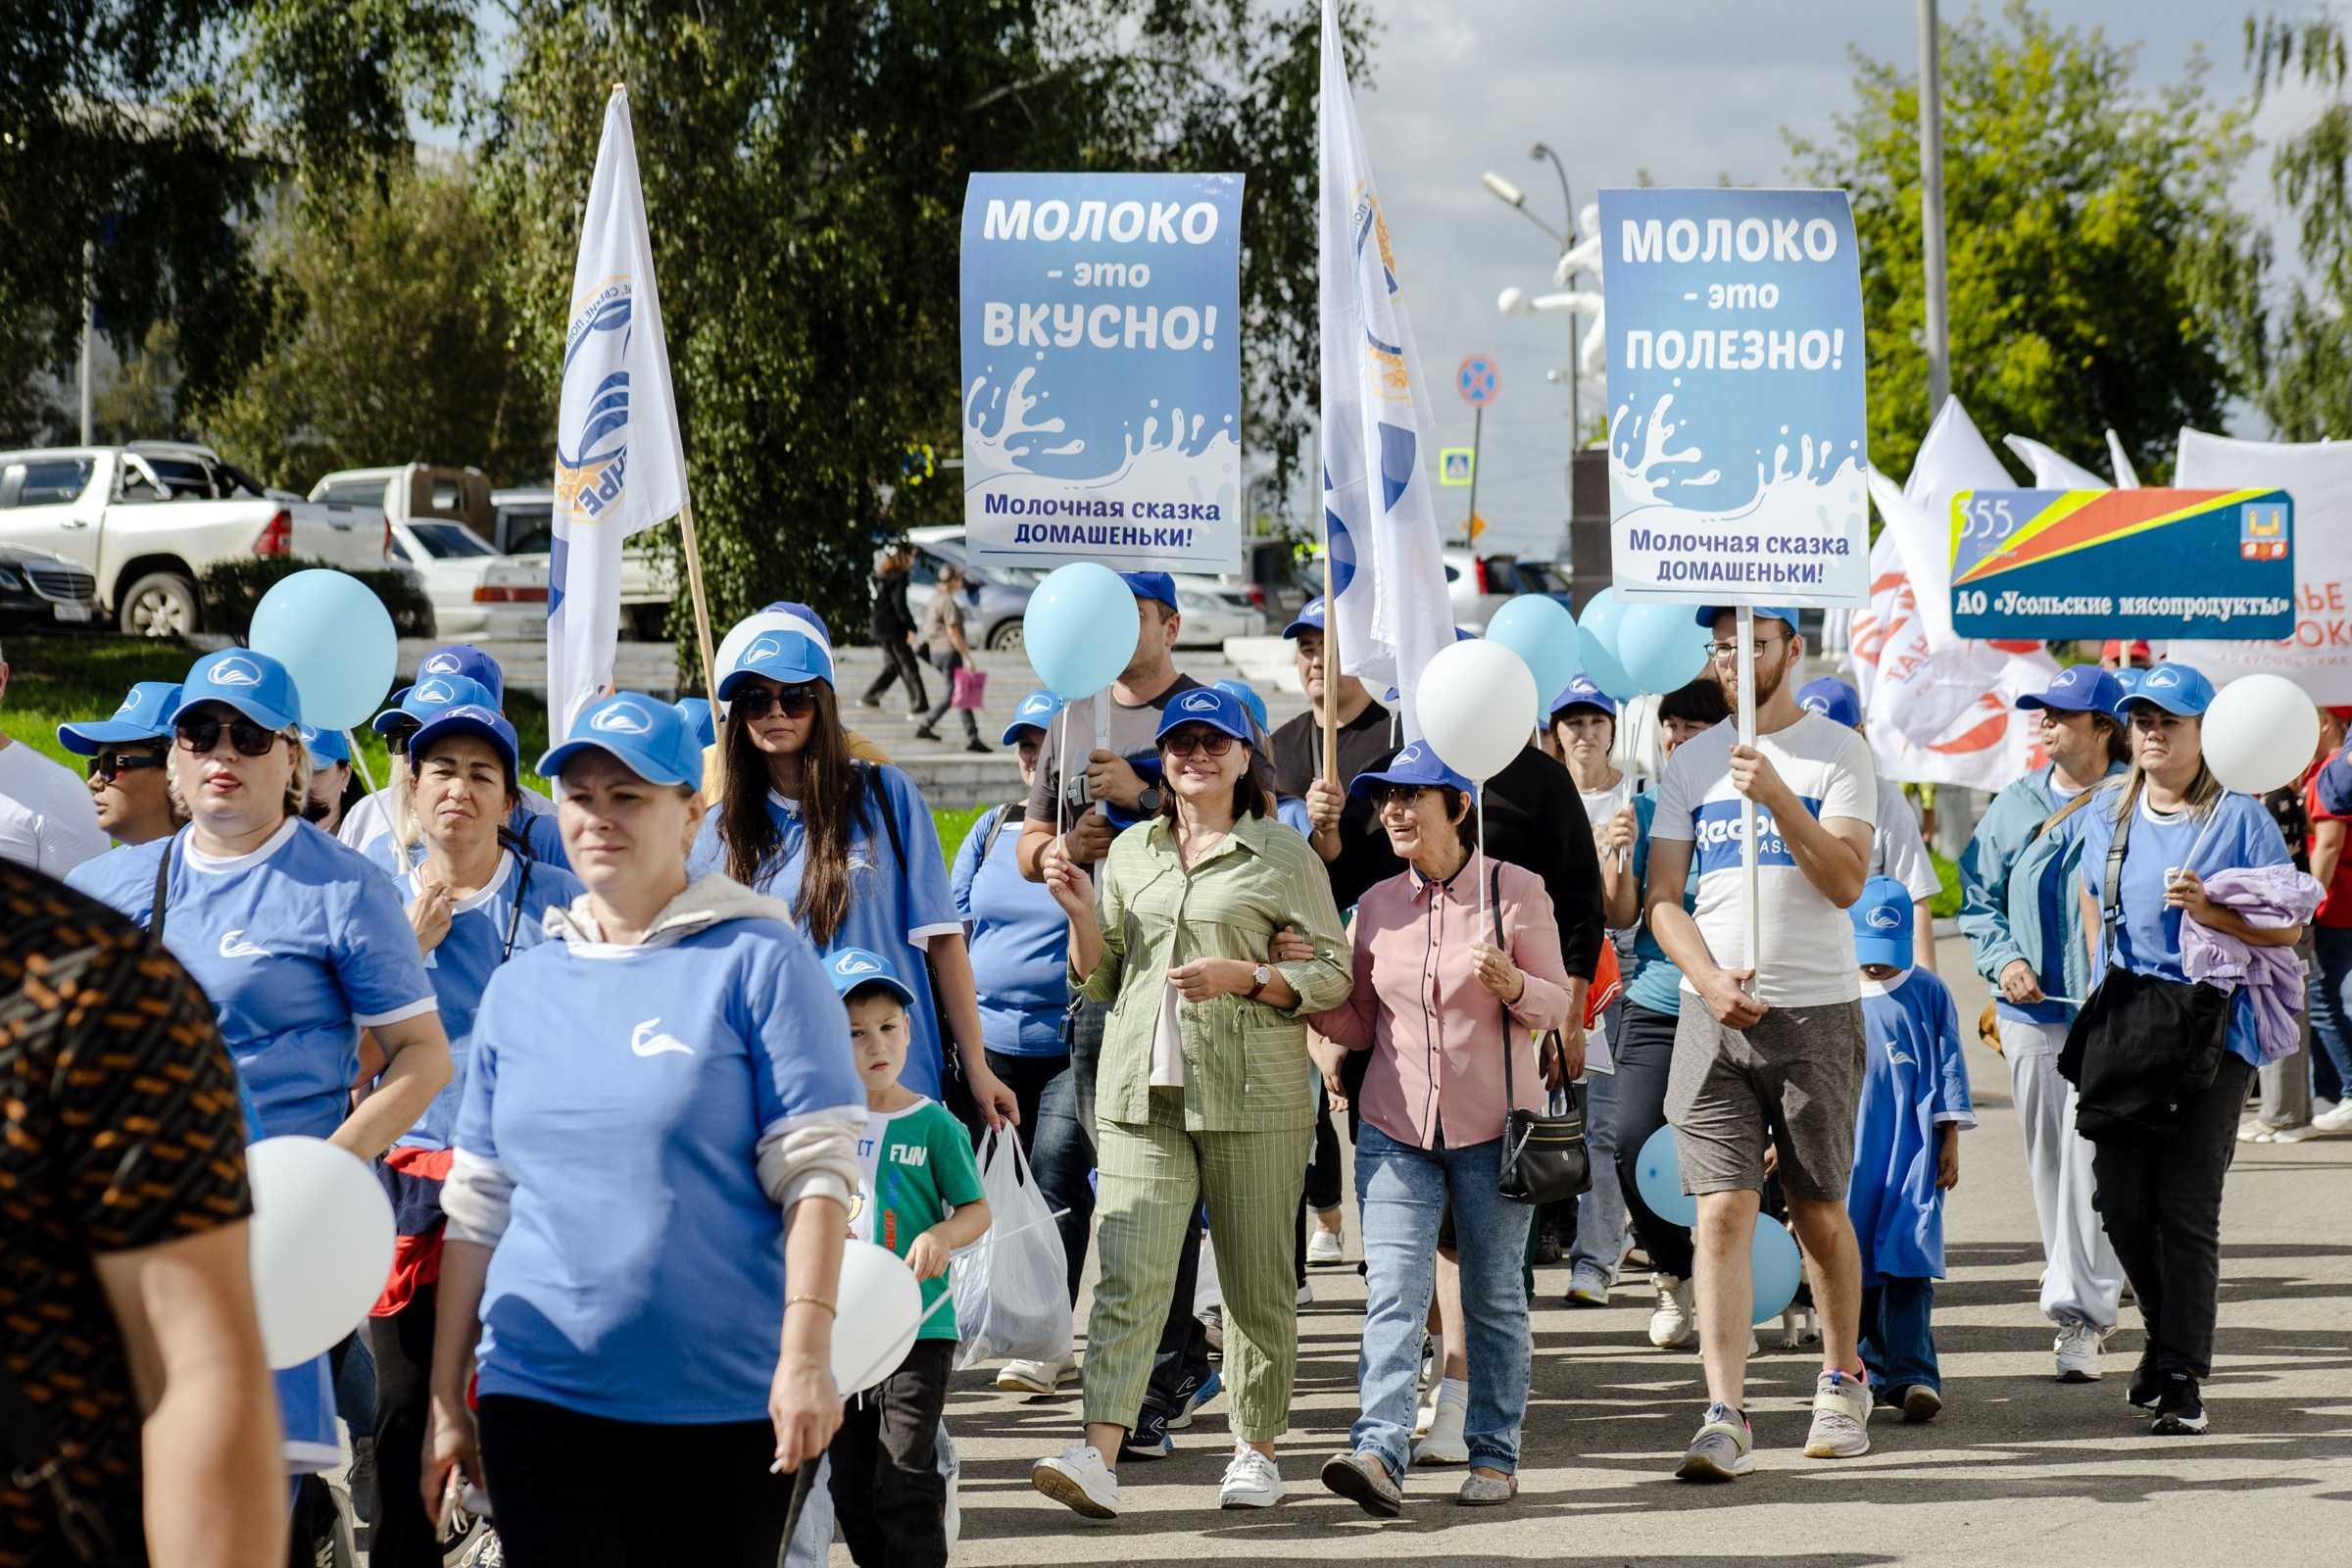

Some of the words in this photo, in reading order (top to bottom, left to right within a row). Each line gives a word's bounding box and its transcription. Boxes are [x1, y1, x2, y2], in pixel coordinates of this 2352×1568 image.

[983, 199, 1218, 244] МОЛОКО
[1622, 218, 1838, 263] МОЛОКО
[1073, 262, 1151, 288] это
[1708, 283, 1780, 309] это
[983, 302, 1217, 351] ВКУСНО!
[1626, 328, 1844, 370] ПОЛЕЗНО!
[985, 493, 1124, 518] Молочная
[1132, 501, 1221, 521] сказка
[1957, 499, 2014, 539] 355
[1014, 523, 1193, 547] ДОМАШЕНЬКИ!
[1630, 529, 1759, 554] Молочная
[1766, 536, 1849, 556] сказка
[1656, 561, 1824, 584] ДОМАШЕНЬКИ!
[1955, 590, 1987, 615] АО
[1993, 590, 2113, 615] «Усольские
[2119, 596, 2290, 622] мясопродукты»
[890, 1144, 927, 1166] FUN
[884, 1208, 897, 1250] JUMP
